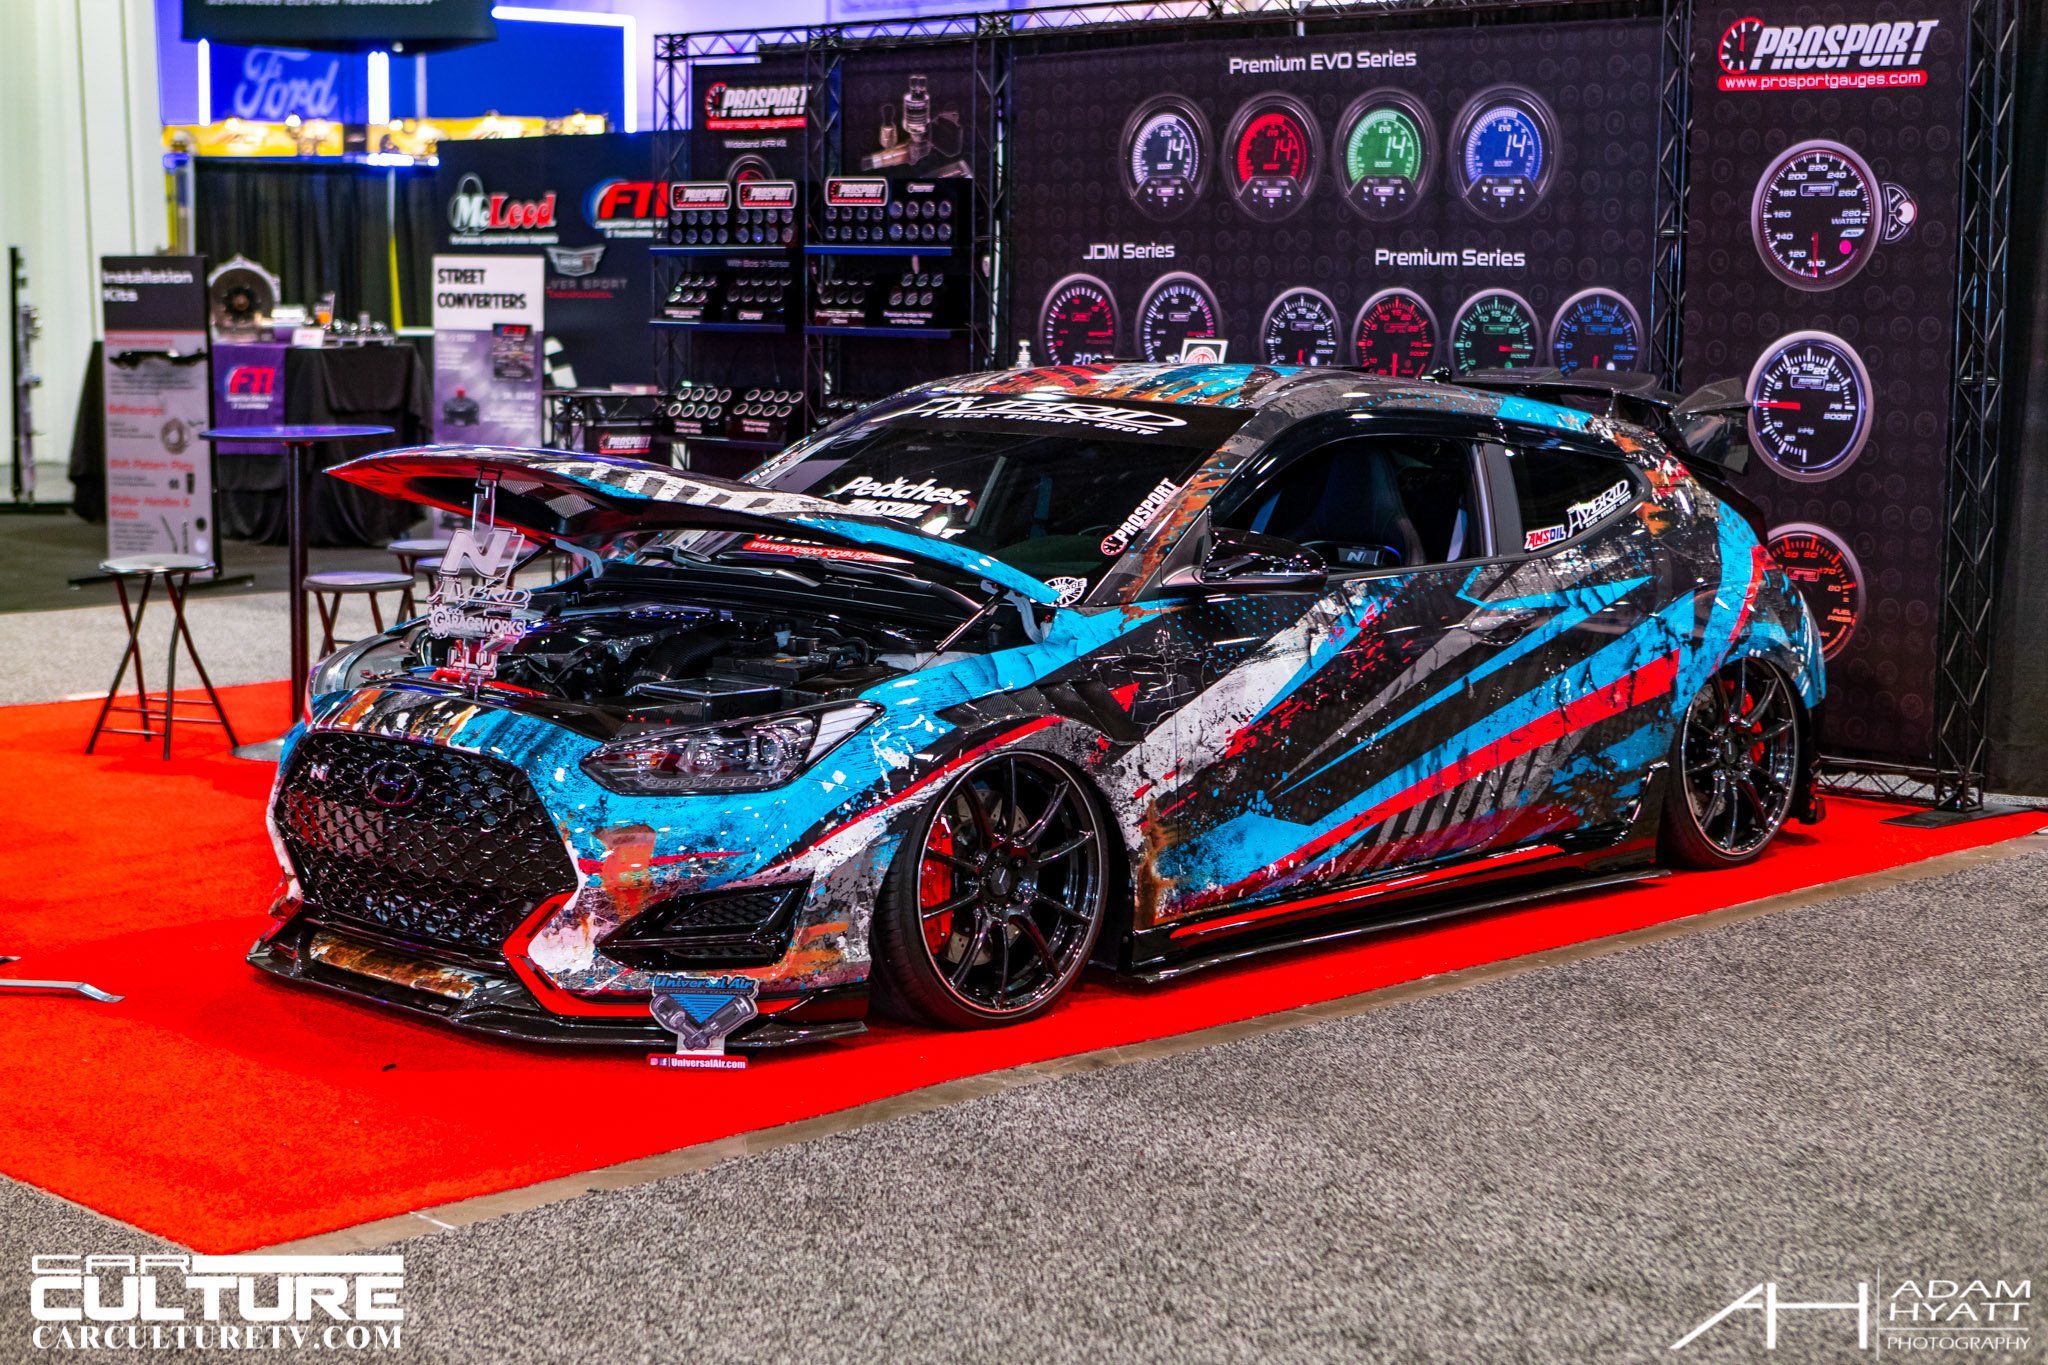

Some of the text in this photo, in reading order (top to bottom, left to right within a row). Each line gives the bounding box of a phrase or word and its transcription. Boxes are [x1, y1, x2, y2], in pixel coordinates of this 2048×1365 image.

[1750, 20, 1939, 71] PROSPORT
[1229, 51, 1417, 75] Premium EVO Series
[233, 47, 340, 119] Ford
[1725, 72, 1921, 90] www.prosportgauges.com
[721, 84, 808, 118] PROSPORT
[1166, 138, 1185, 161] 14
[1273, 138, 1292, 161] 14
[1385, 134, 1407, 159] 14
[1505, 134, 1527, 158] 14
[1808, 164, 1828, 172] 220
[1787, 173, 1808, 181] 200
[1826, 171, 1847, 180] 240
[1779, 189, 1797, 197] 180
[1838, 189, 1858, 198] 260
[453, 191, 557, 230] McLeod
[1841, 209, 1861, 217] 280
[1083, 242, 1175, 260] JDM Series
[1375, 247, 1526, 267] Premium Series
[1788, 250, 1807, 258] 120
[103, 268, 193, 284] Installation
[438, 268, 486, 285] STREET
[437, 293, 527, 310] CONVERTERS
[1287, 312, 1296, 320] 10
[1306, 312, 1318, 320] 20
[1479, 315, 1489, 323] 10
[1500, 315, 1513, 323] 20
[1602, 315, 1615, 323] 20
[1786, 367, 1800, 375] 10
[1801, 363, 1814, 371] 15
[1813, 367, 1829, 375] 20
[229, 367, 275, 395] FTI
[1774, 381, 1783, 389] 5
[1823, 413, 1853, 421] BOOST
[1094, 422, 1159, 435] SHOW
[608, 435, 651, 449] PROSPORT
[1113, 477, 1177, 543] PROSPORT
[1567, 479, 1629, 538] HYBRID
[1525, 525, 1566, 549] AMSOIL
[433, 611, 525, 636] GARAGEWORKS
[654, 975, 754, 989] Universal Air
[671, 1058, 746, 1069] UniversalAir.com
